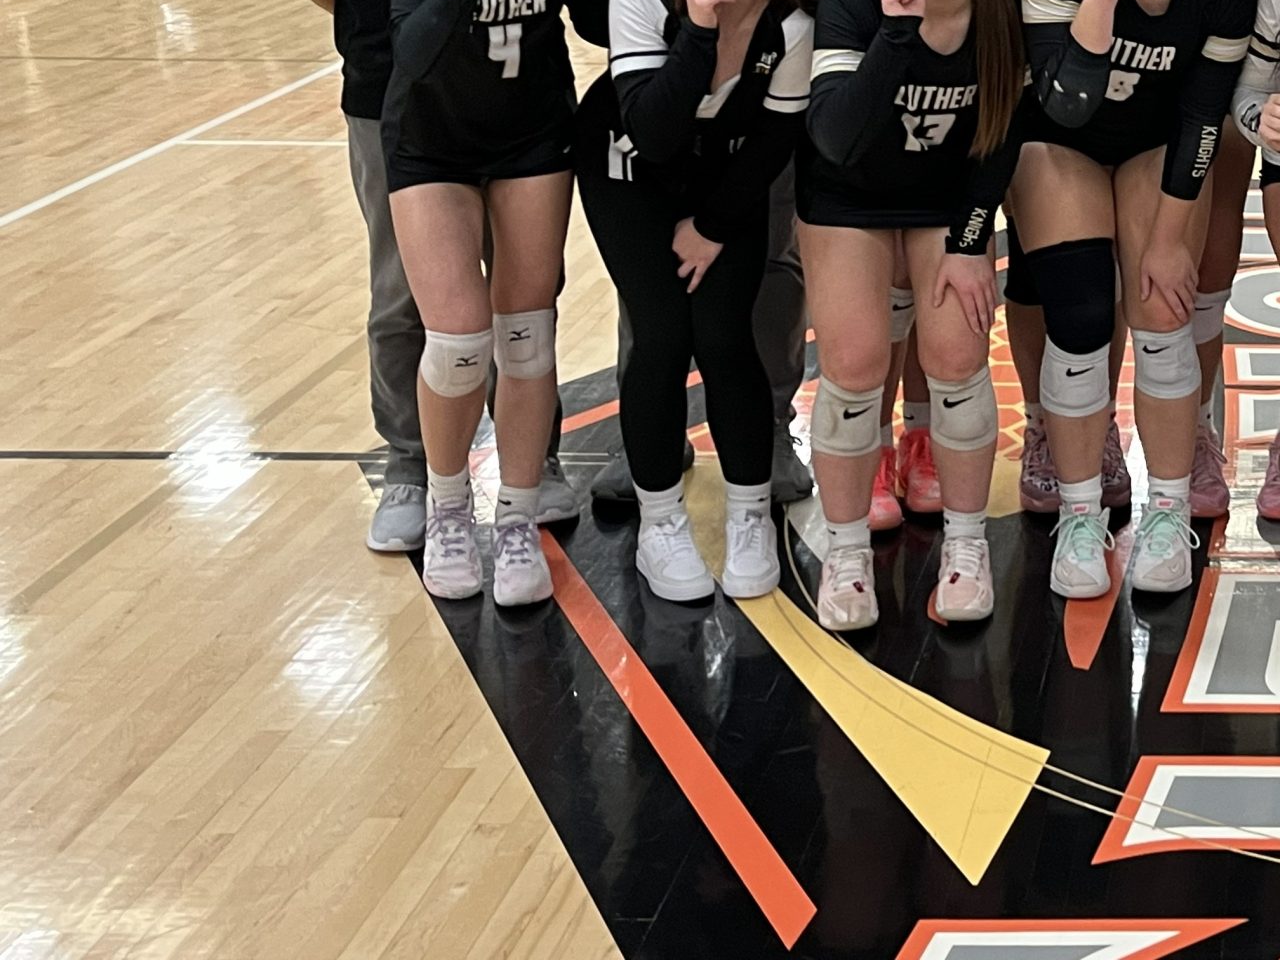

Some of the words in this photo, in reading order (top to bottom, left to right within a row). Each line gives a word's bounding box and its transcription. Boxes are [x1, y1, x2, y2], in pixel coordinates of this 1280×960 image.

[487, 23, 523, 80] 4
[893, 84, 979, 112] LUTHER
[1191, 125, 1219, 179] KNIGHTS
